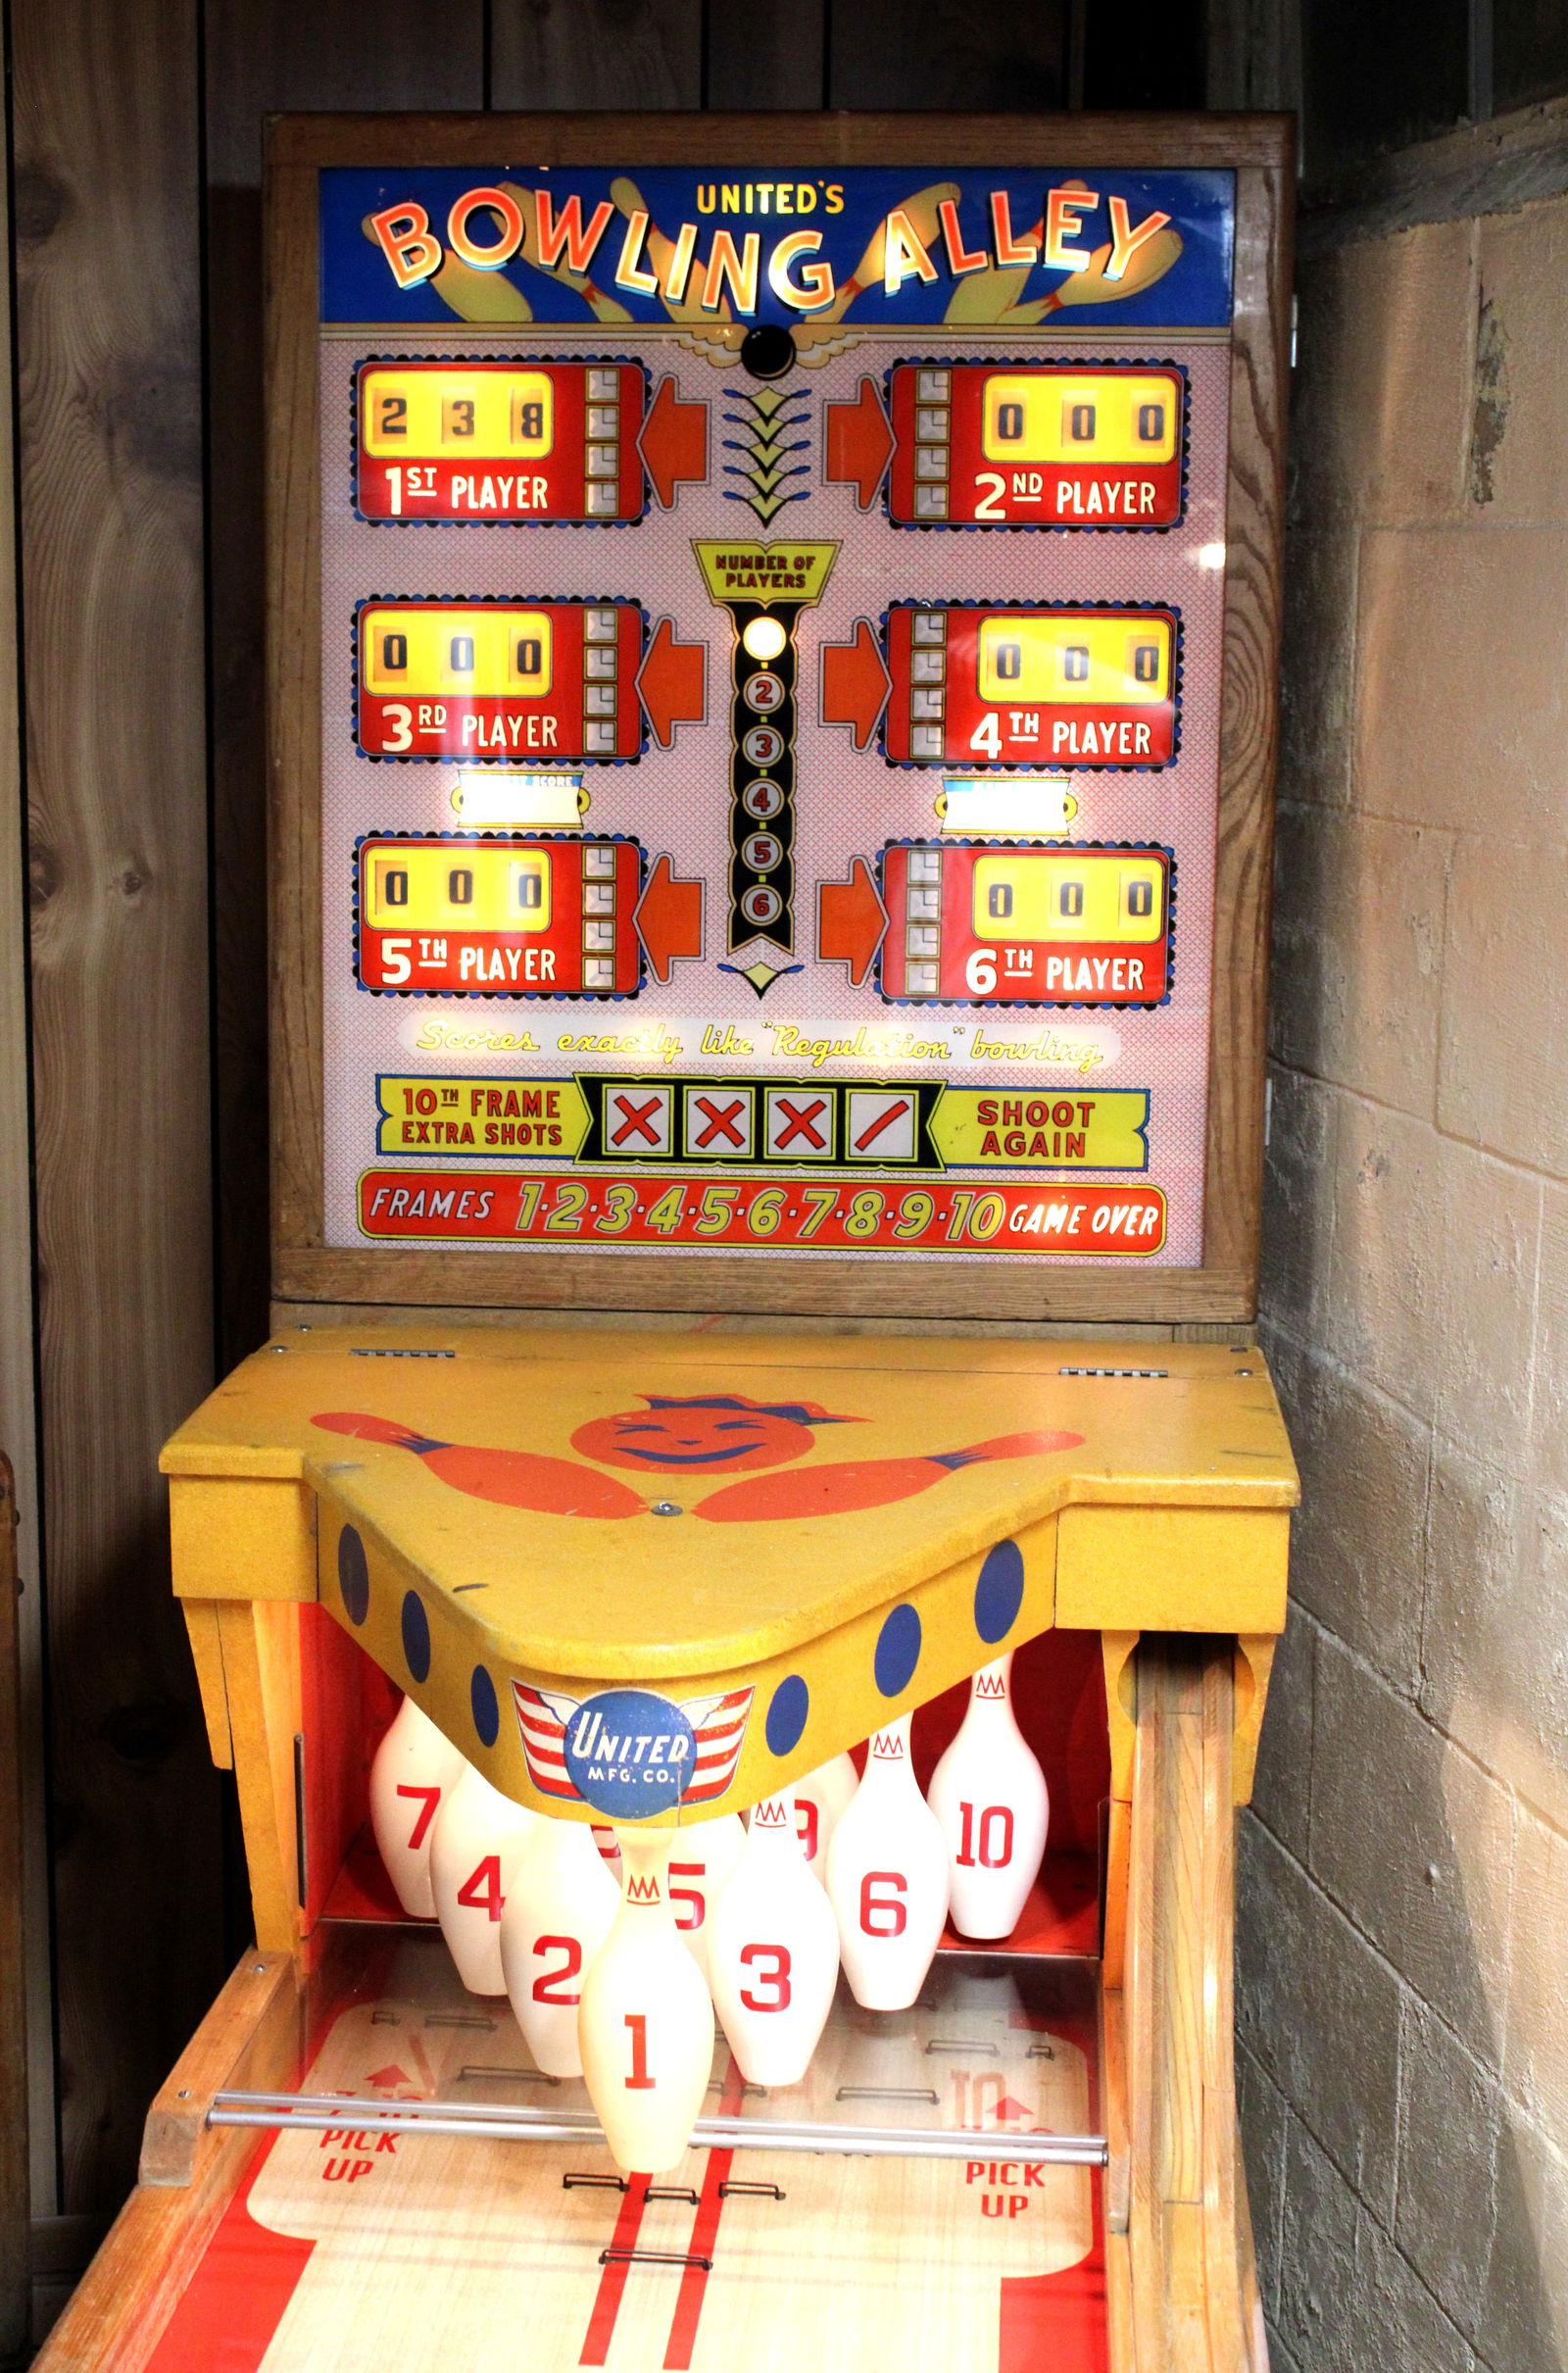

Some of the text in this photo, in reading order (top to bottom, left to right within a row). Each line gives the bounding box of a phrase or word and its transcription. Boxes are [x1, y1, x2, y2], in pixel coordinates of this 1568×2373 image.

[697, 180, 845, 214] UNITED'S
[371, 186, 1171, 314] BOWLING ALLEY
[451, 475, 548, 509] PLAYER
[1056, 481, 1155, 515] PLAYER
[715, 555, 816, 570] NUMBER OF
[725, 573, 807, 588] PLAYERS
[755, 680, 773, 704] 2
[462, 715, 558, 747] PLAYER
[755, 734, 773, 758] 3
[1052, 720, 1151, 755] PLAYER
[753, 788, 770, 812] 4
[754, 841, 771, 864] 5
[753, 894, 769, 915] 6
[460, 947, 556, 981] PLAYER
[1047, 957, 1144, 991] PLAYER
[416, 1018, 539, 1051] Scores
[557, 1023, 683, 1063] exactly
[701, 1025, 754, 1055] like
[970, 1029, 1103, 1072] bowling
[471, 1089, 560, 1118] FRAME
[977, 1101, 1096, 1128] SHOOT
[402, 1121, 563, 1146] EXTRA SHOTS
[980, 1131, 1086, 1159] AGAIN
[369, 1188, 494, 1219] FRAMES
[1008, 1203, 1087, 1236] GAME
[1092, 1205, 1158, 1236] OVER
[572, 1711, 689, 1763] UNITED
[588, 1766, 675, 1784] MFG. CO.
[397, 1784, 441, 1850] 7
[956, 1802, 1014, 1868] 10
[458, 1855, 506, 1922] 4
[859, 1871, 907, 1938] 6
[532, 1935, 582, 2005] 2
[740, 1944, 792, 2013] 3
[624, 2014, 657, 2090] 1
[318, 2129, 402, 2153] PICK
[321, 2157, 374, 2183] UP
[965, 2160, 1046, 2188] PICK
[981, 2194, 1029, 2219] UP
